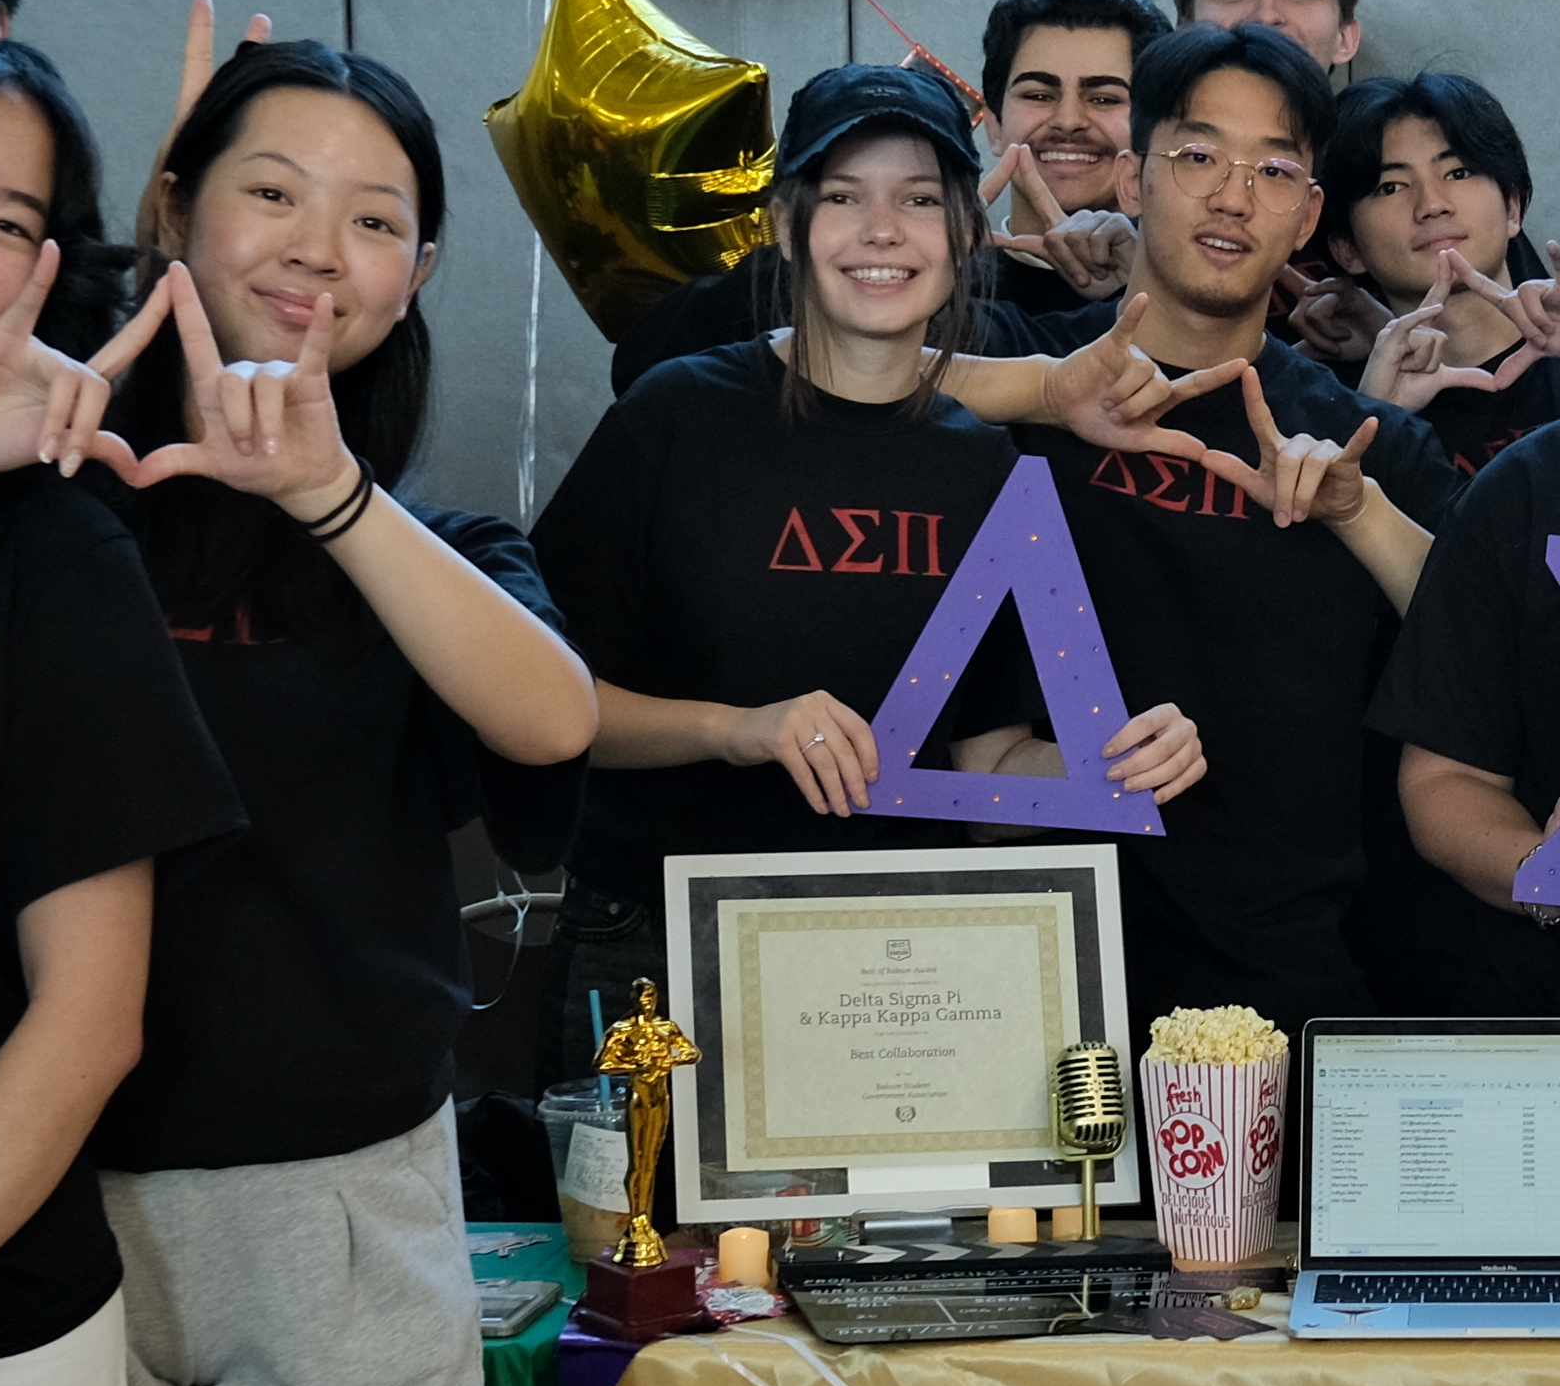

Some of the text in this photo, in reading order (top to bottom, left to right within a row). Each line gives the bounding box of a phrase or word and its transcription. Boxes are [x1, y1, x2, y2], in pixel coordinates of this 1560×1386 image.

[769, 506, 948, 576] ΔΣΠ
[839, 989, 962, 1009] Delta Sigma Pi
[800, 1007, 1002, 1028] & Kappa Kappa Gamma
[850, 1046, 956, 1060] Best Collaboration
[1166, 1082, 1202, 1112] fresh
[1160, 1119, 1205, 1154] POP
[1169, 1140, 1225, 1178] CORN
[1162, 1193, 1211, 1210] DELICIOUS
[1174, 1211, 1231, 1229] NUTRITIOUS
